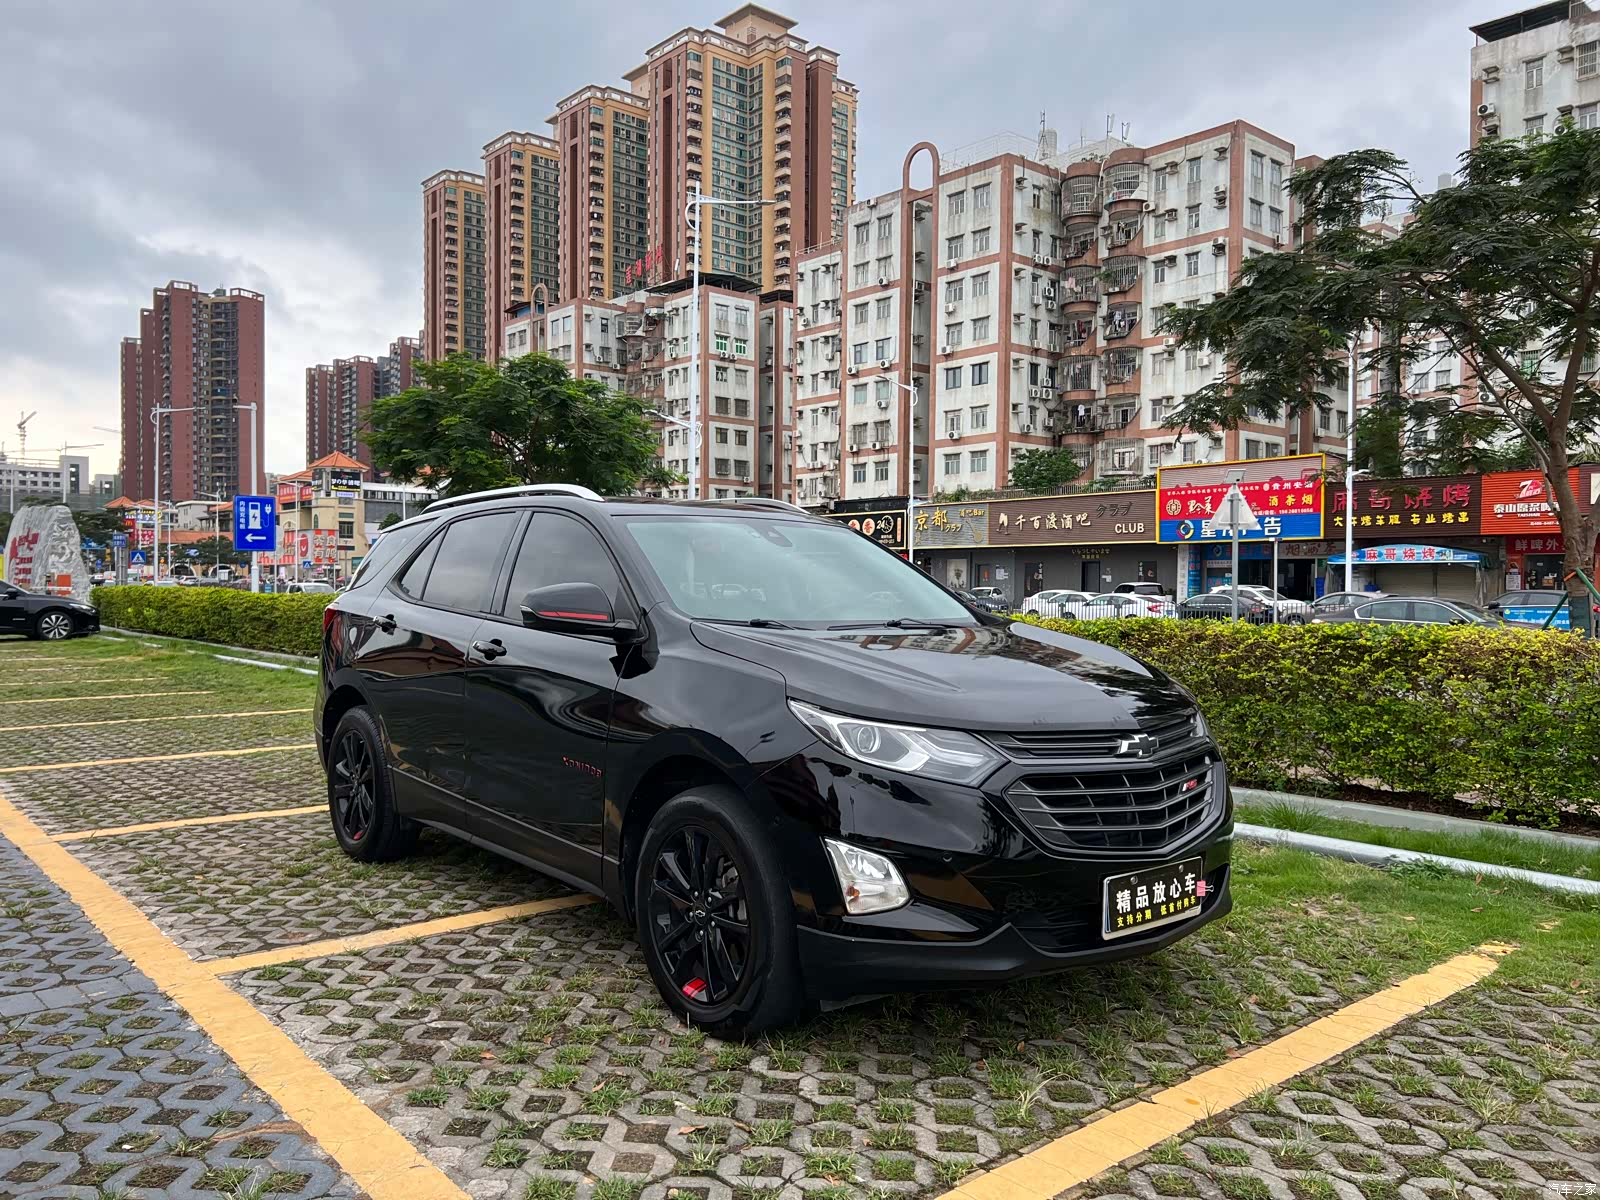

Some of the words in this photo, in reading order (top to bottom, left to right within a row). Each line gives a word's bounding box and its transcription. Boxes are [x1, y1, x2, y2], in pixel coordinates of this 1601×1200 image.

[1493, 502, 1560, 513] 泰山原浆啤
[914, 507, 948, 531] 京都
[1114, 522, 1145, 534] CLUB
[1514, 538, 1566, 551] 鲜啤外
[1366, 548, 1436, 561] 麻哥烧烤
[1116, 872, 1196, 914] 精品放心车
[1117, 908, 1152, 928] 支持分期
[1160, 895, 1196, 916] 低首付购车
